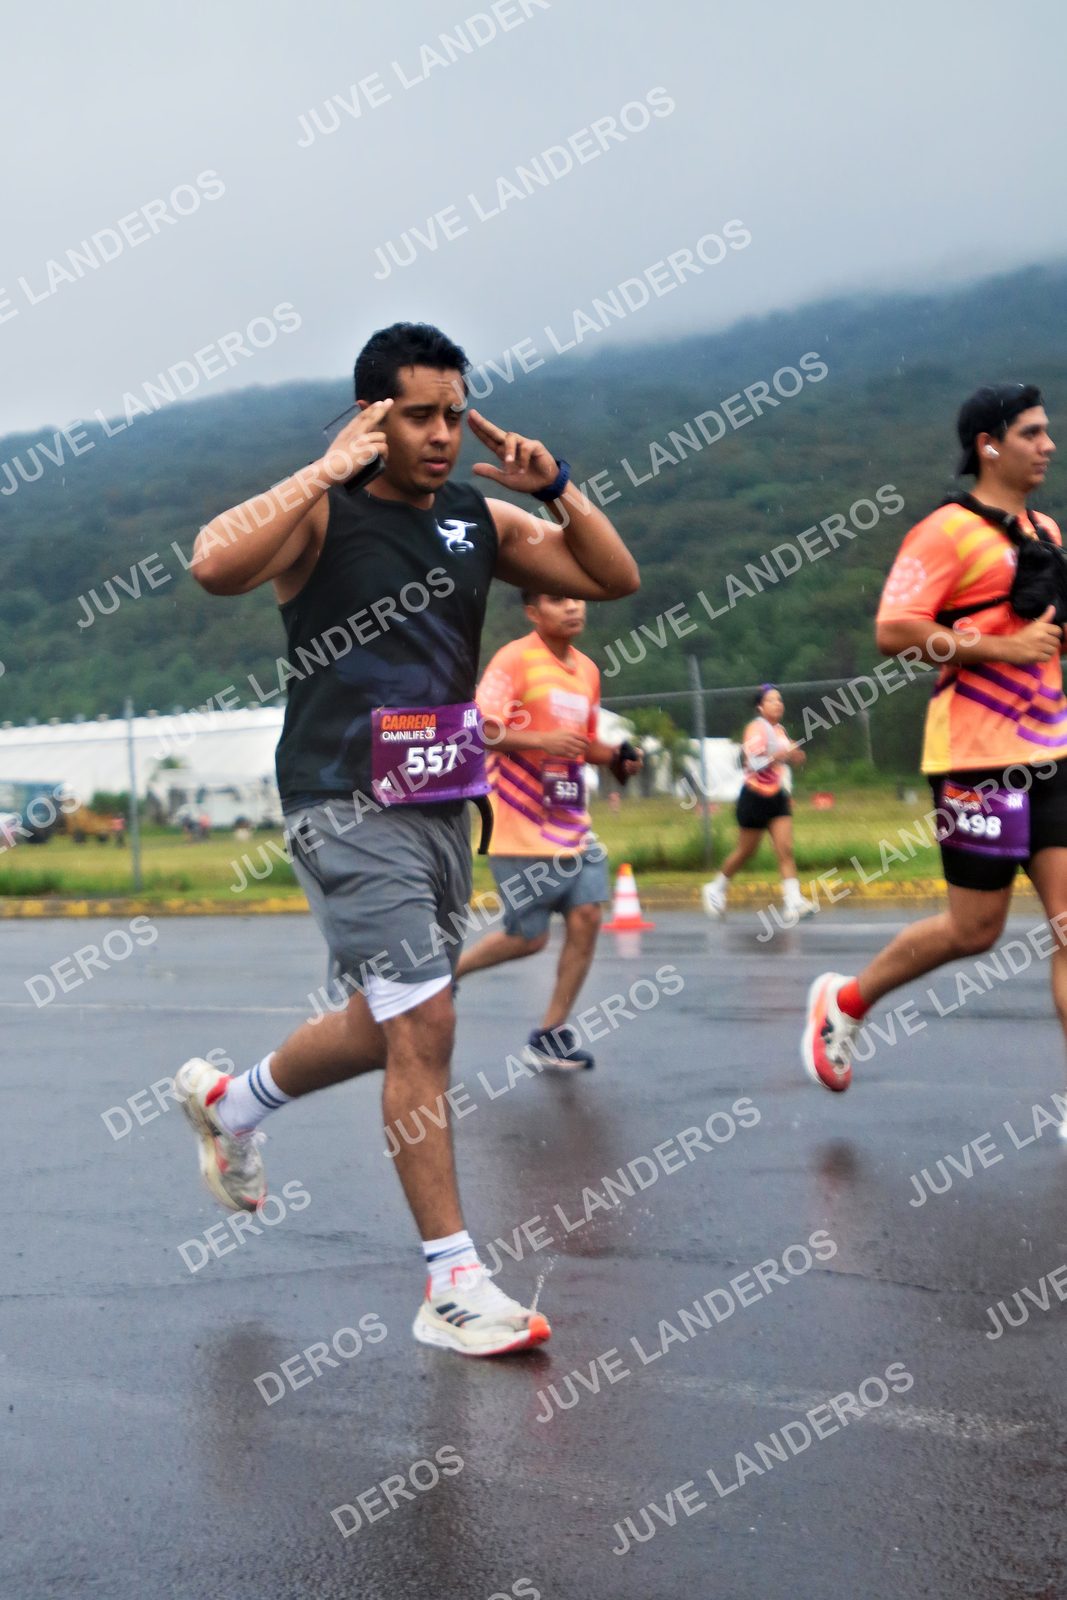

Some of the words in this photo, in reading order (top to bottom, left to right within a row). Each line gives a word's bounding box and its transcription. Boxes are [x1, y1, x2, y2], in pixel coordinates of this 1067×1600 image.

[382, 714, 437, 731] CARRERA
[382, 730, 424, 741] OMNILIFE
[407, 744, 458, 776] 557
